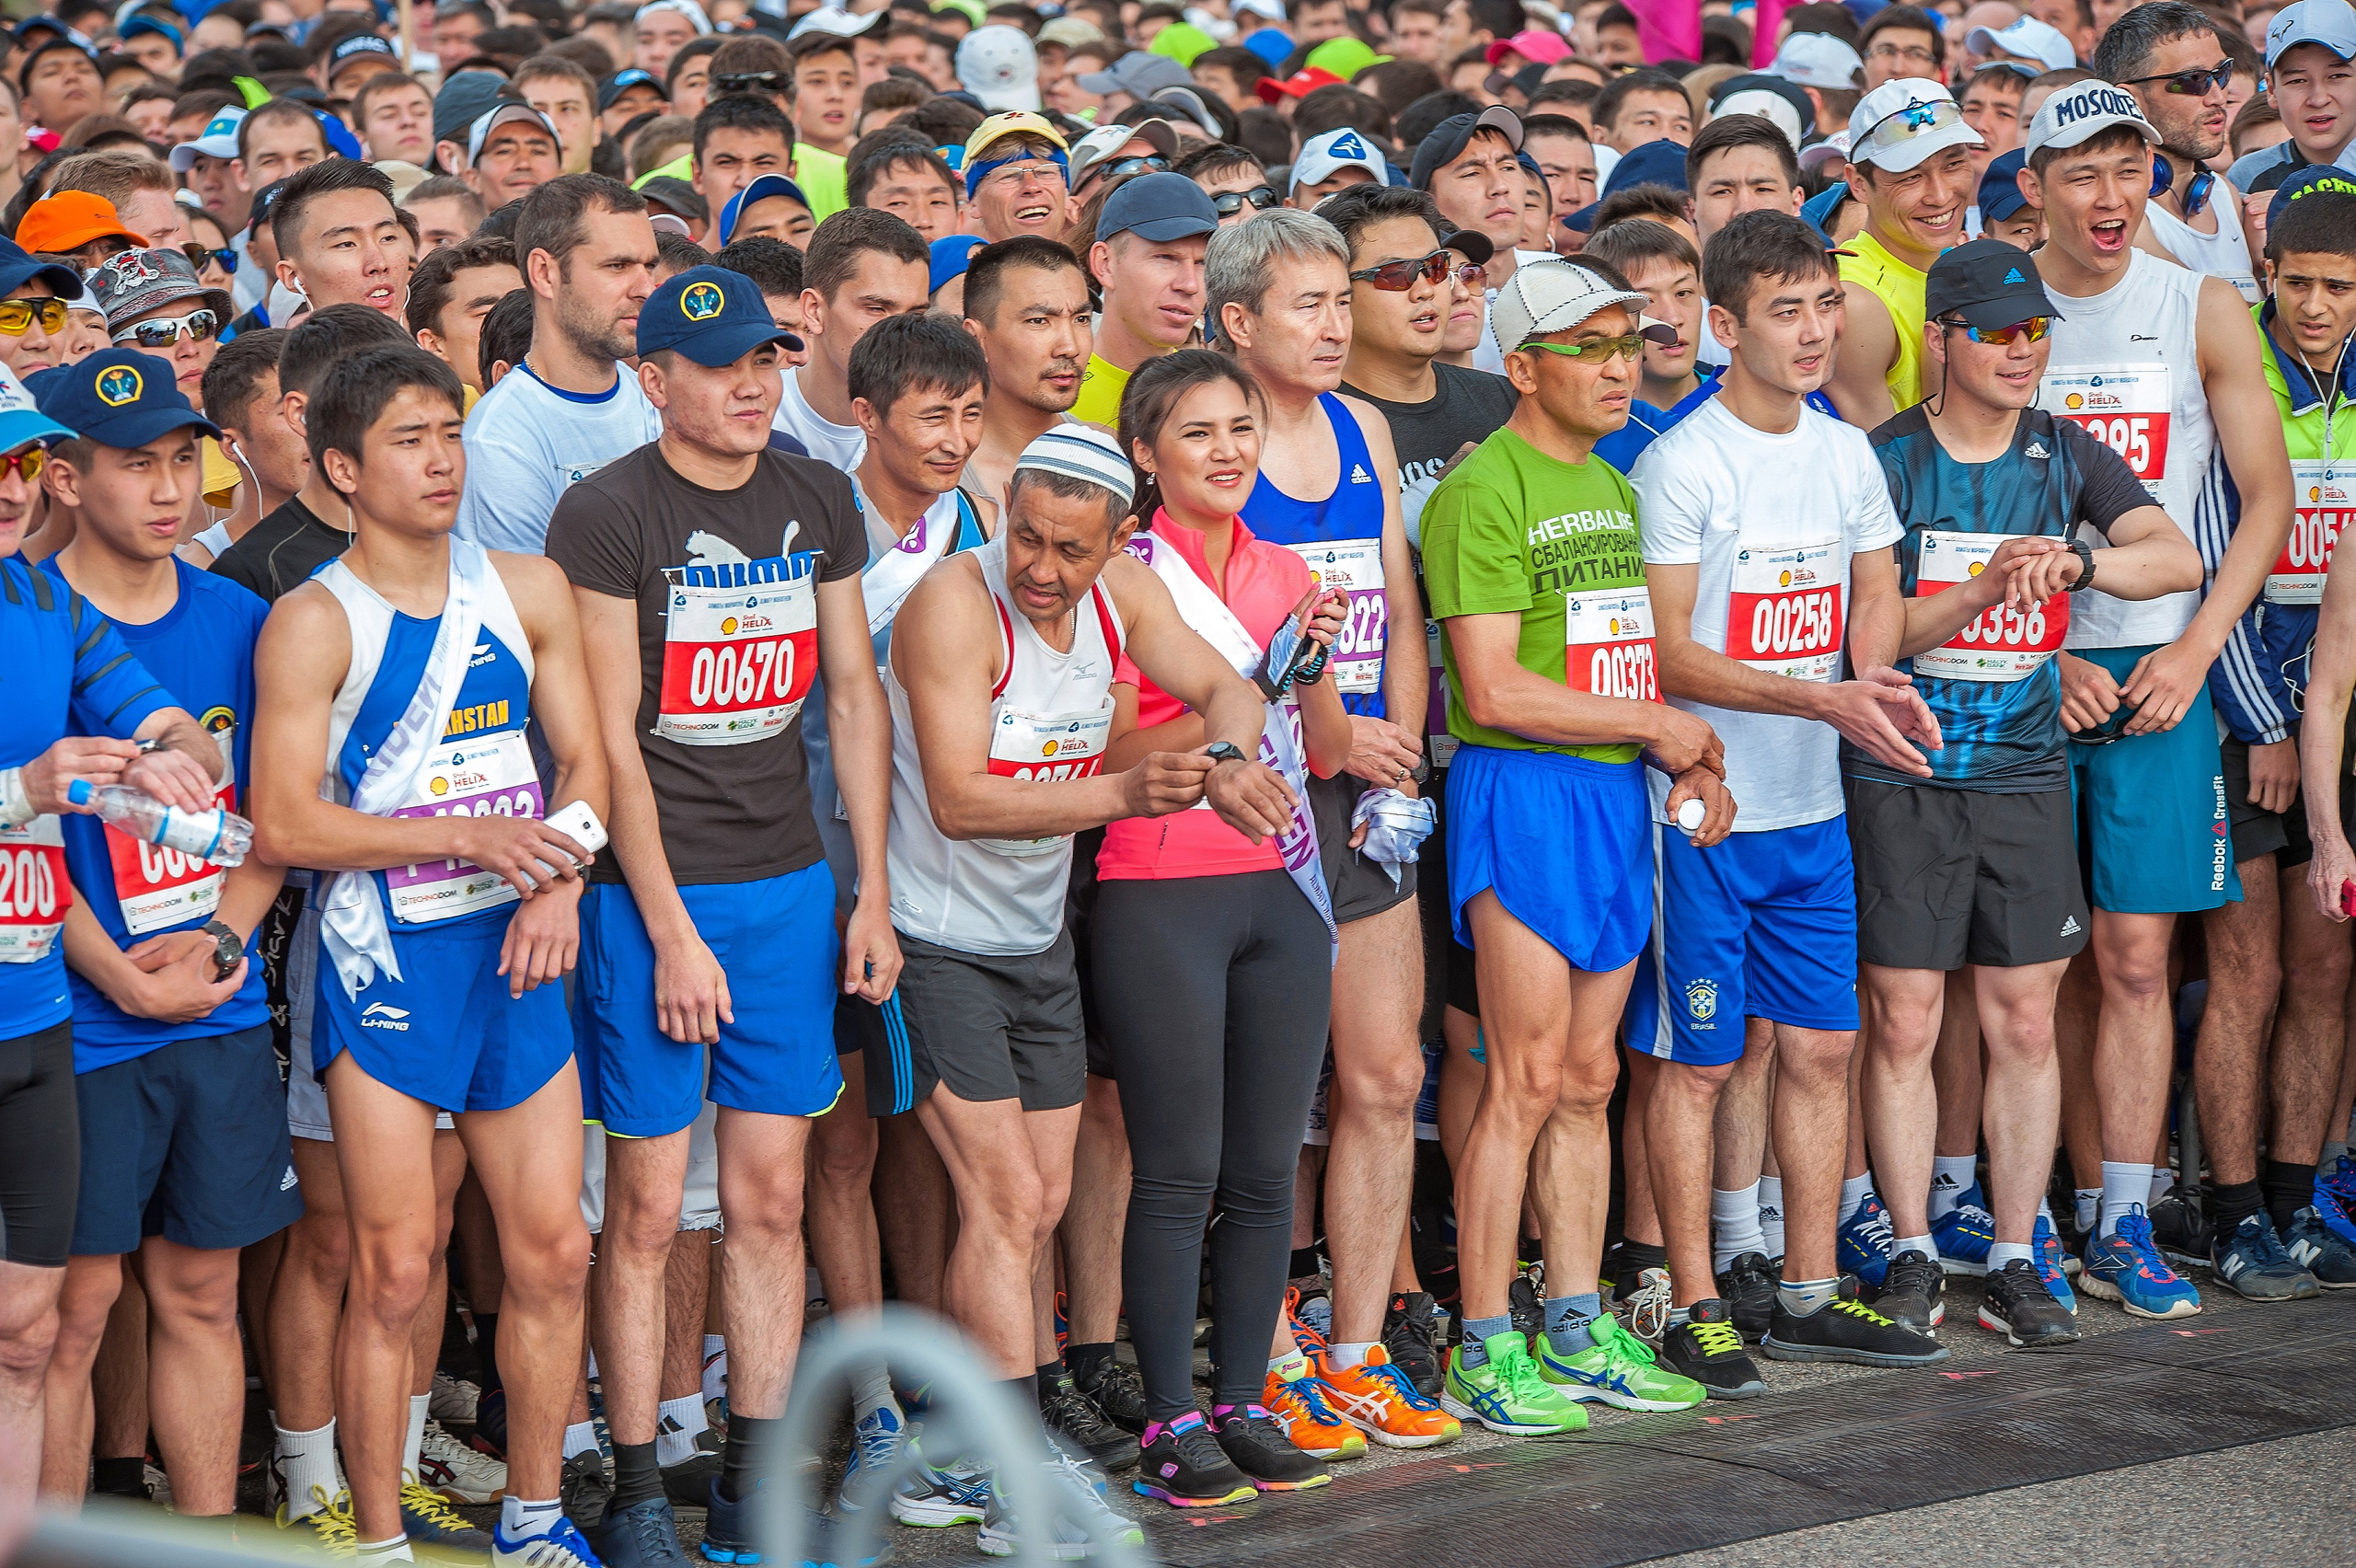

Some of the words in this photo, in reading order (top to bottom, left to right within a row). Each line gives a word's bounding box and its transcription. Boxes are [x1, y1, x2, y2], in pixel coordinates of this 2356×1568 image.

[2088, 395, 2121, 405] HELIX
[2289, 513, 2356, 567] 005
[1325, 571, 1353, 582] HELIX
[1531, 556, 1646, 596] ПИТАНИ
[742, 617, 772, 628] HELIX
[1335, 594, 1385, 657] 822
[1751, 591, 1833, 654] 00258
[1953, 594, 2046, 646] 356
[467, 652, 496, 668] -NING
[1925, 654, 1968, 664] TECHNODOM
[690, 639, 794, 707] 00670
[1590, 643, 1656, 700] 00373
[1061, 740, 1089, 752] HELIX
[455, 773, 488, 788] HELIX
[2213, 775, 2226, 820] CrossFit
[2211, 838, 2226, 891] Reebok
[137, 897, 182, 914] TECHNODOM
[409, 890, 456, 905] TECHNODOM
[361, 1019, 410, 1032] LI-NING
